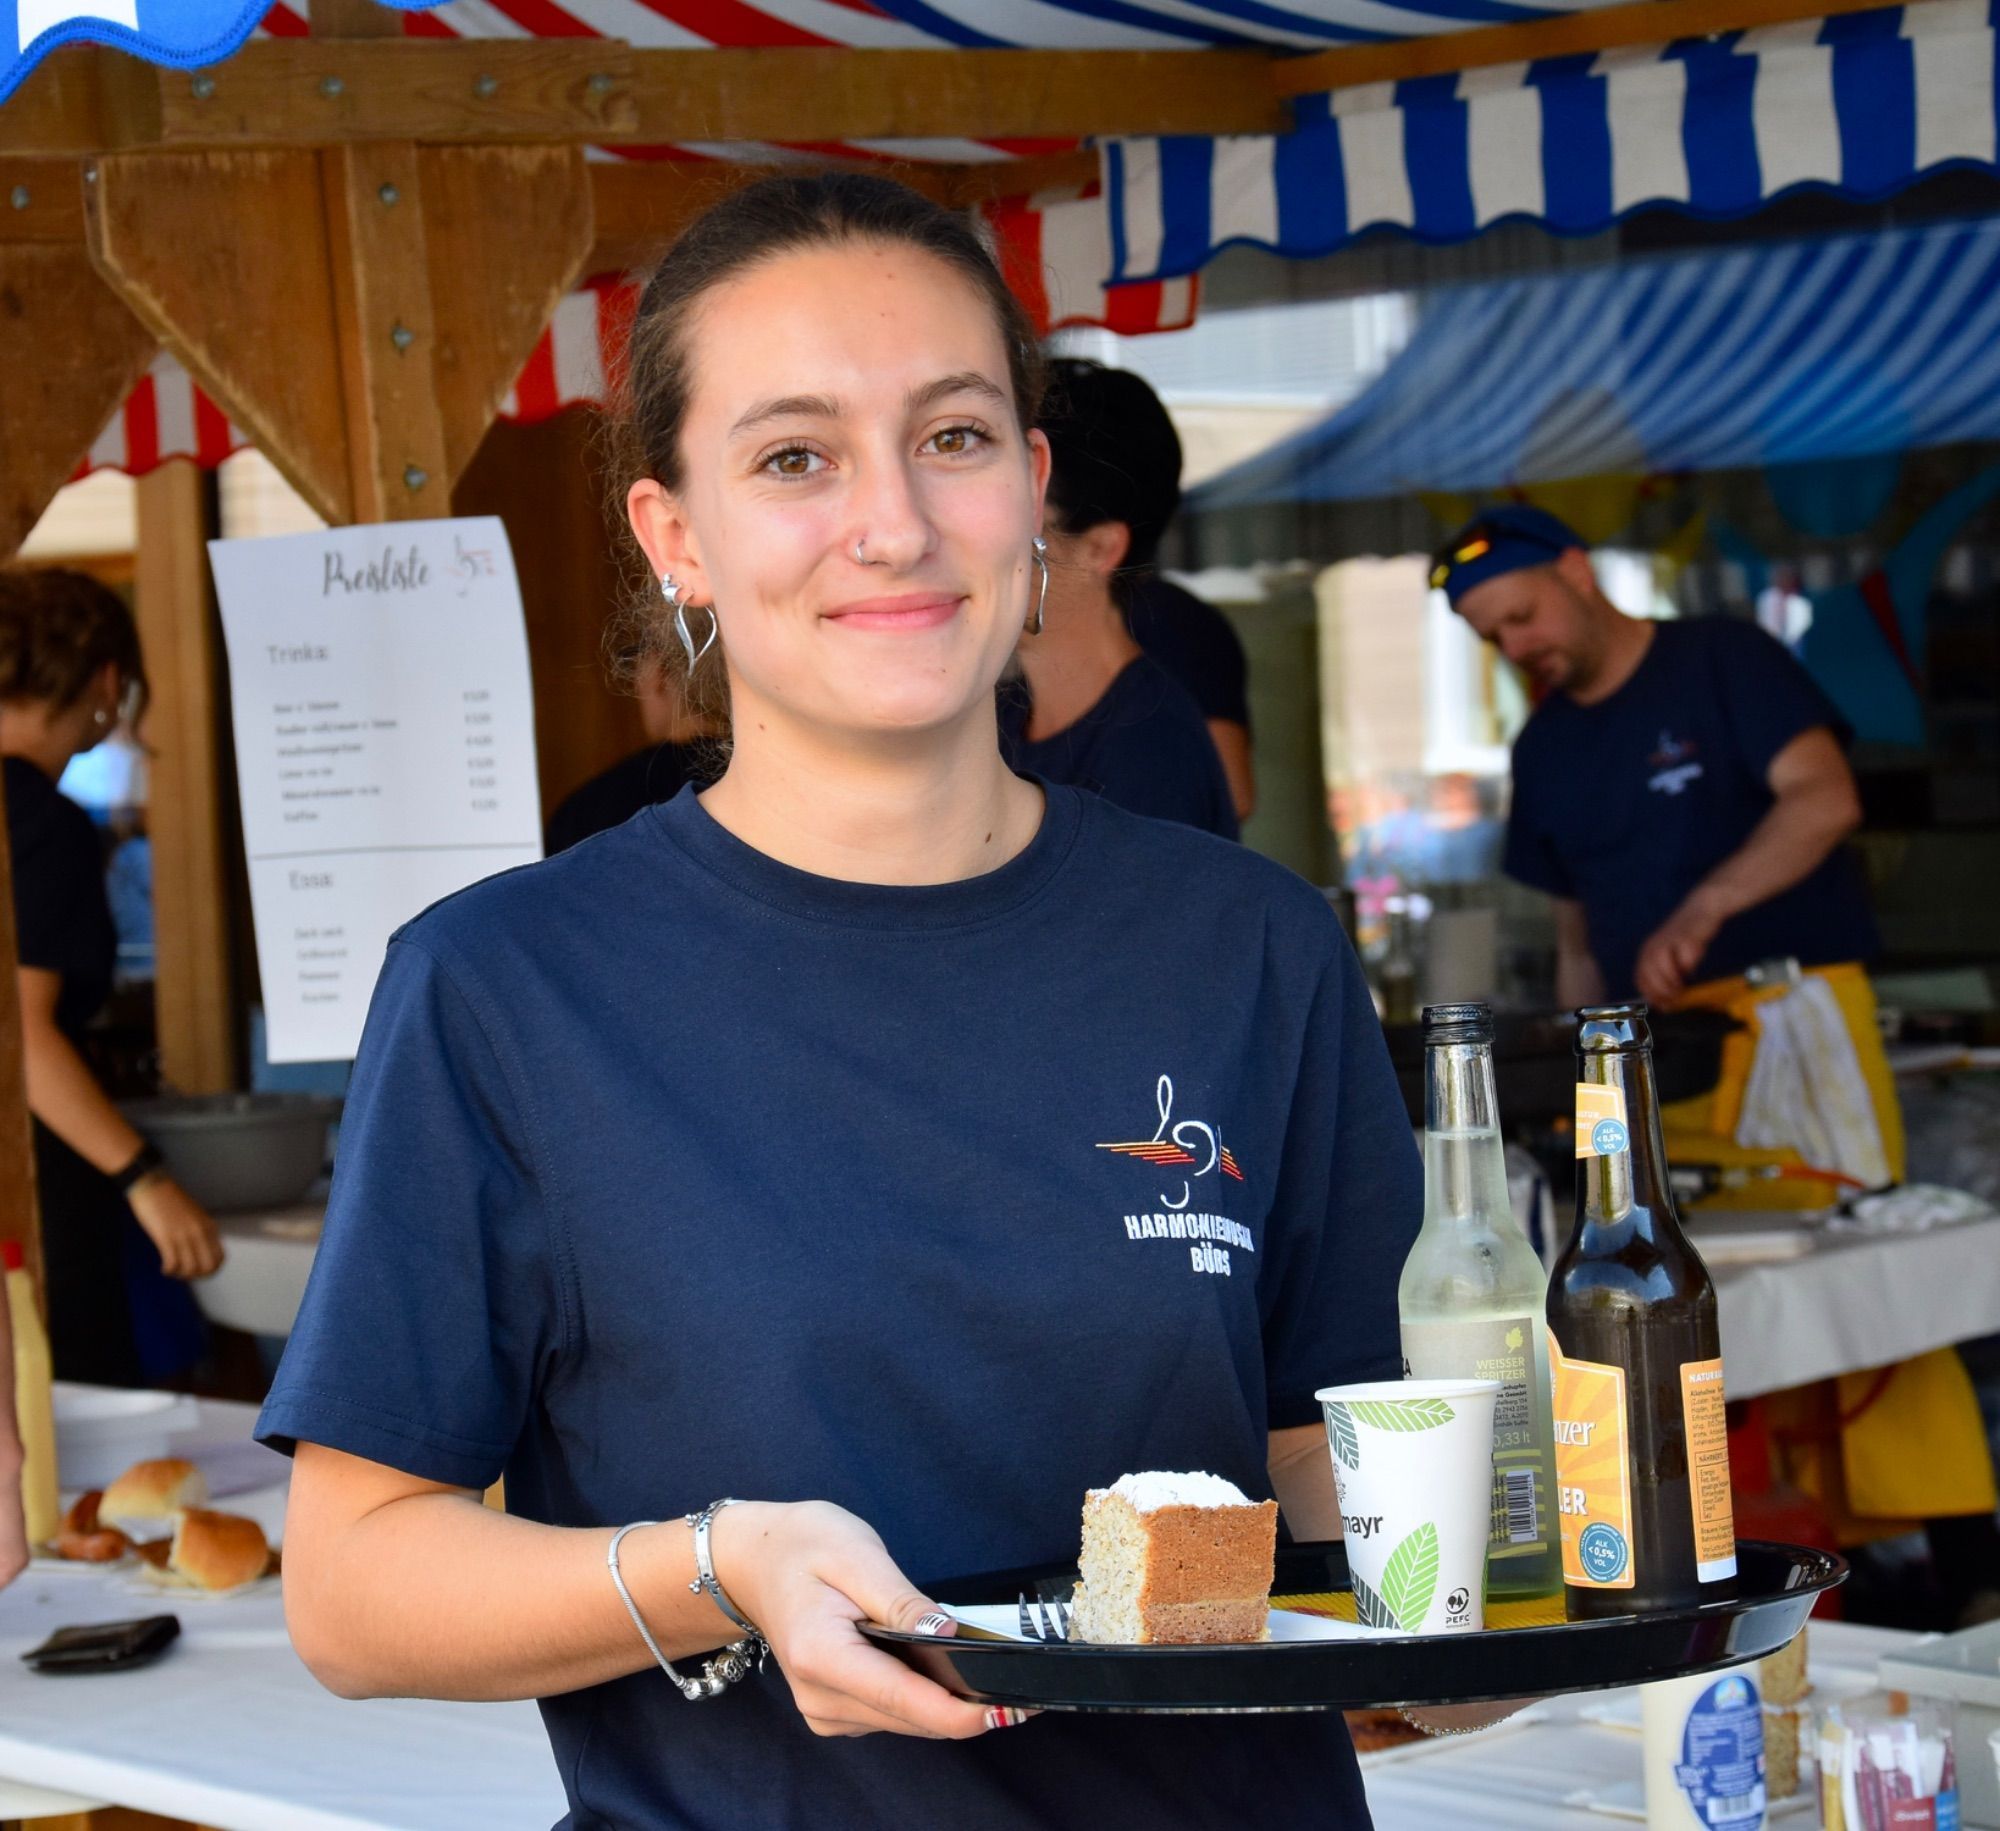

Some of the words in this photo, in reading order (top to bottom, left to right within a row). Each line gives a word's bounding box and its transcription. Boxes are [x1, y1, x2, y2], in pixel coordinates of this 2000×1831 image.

[322, 544, 430, 596] Preisliste
[1476, 1357, 1525, 1370] WEISSER
[1474, 1368, 1526, 1381] SPRITZER
[1594, 1557, 1607, 1566] VOL
[1445, 1614, 1470, 1625] PEFC
